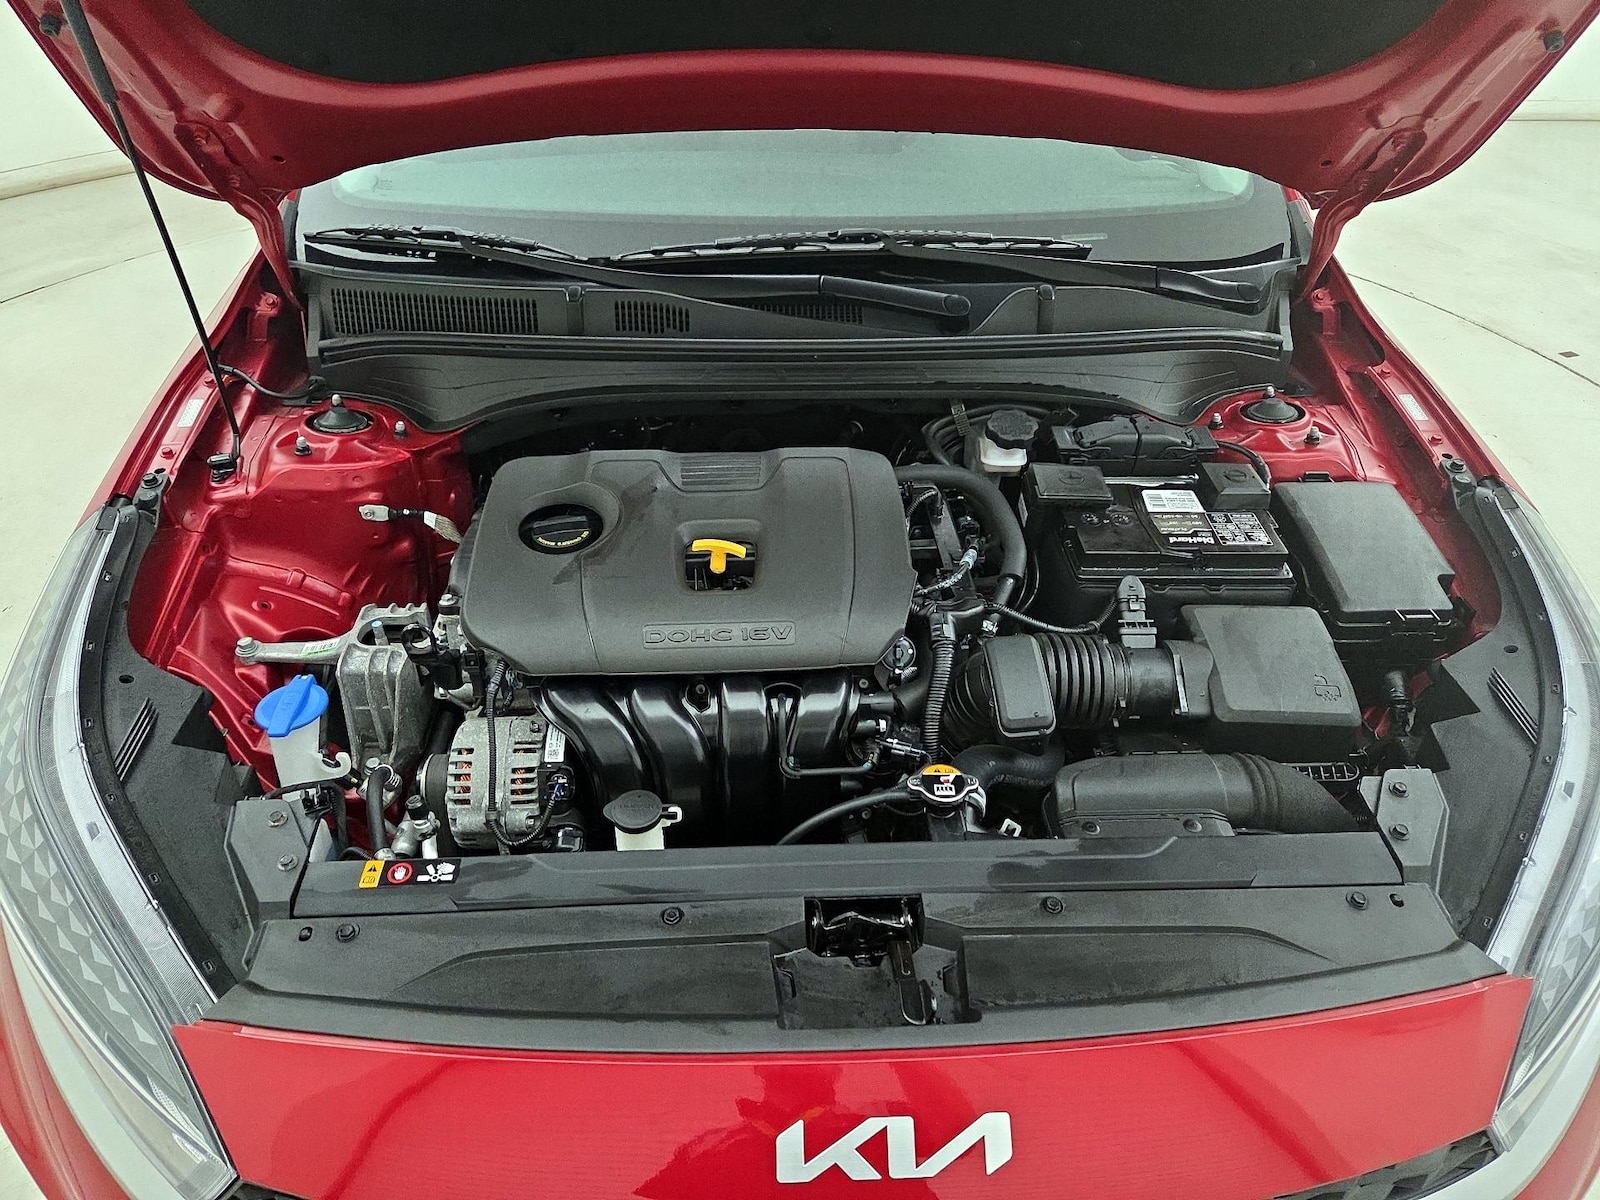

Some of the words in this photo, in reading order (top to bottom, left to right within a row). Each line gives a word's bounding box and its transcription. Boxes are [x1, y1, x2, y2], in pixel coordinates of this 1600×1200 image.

[1168, 536, 1215, 544] DieHard
[645, 628, 732, 644] DOHC
[741, 626, 793, 641] 16V
[775, 1111, 1014, 1184] KIA
